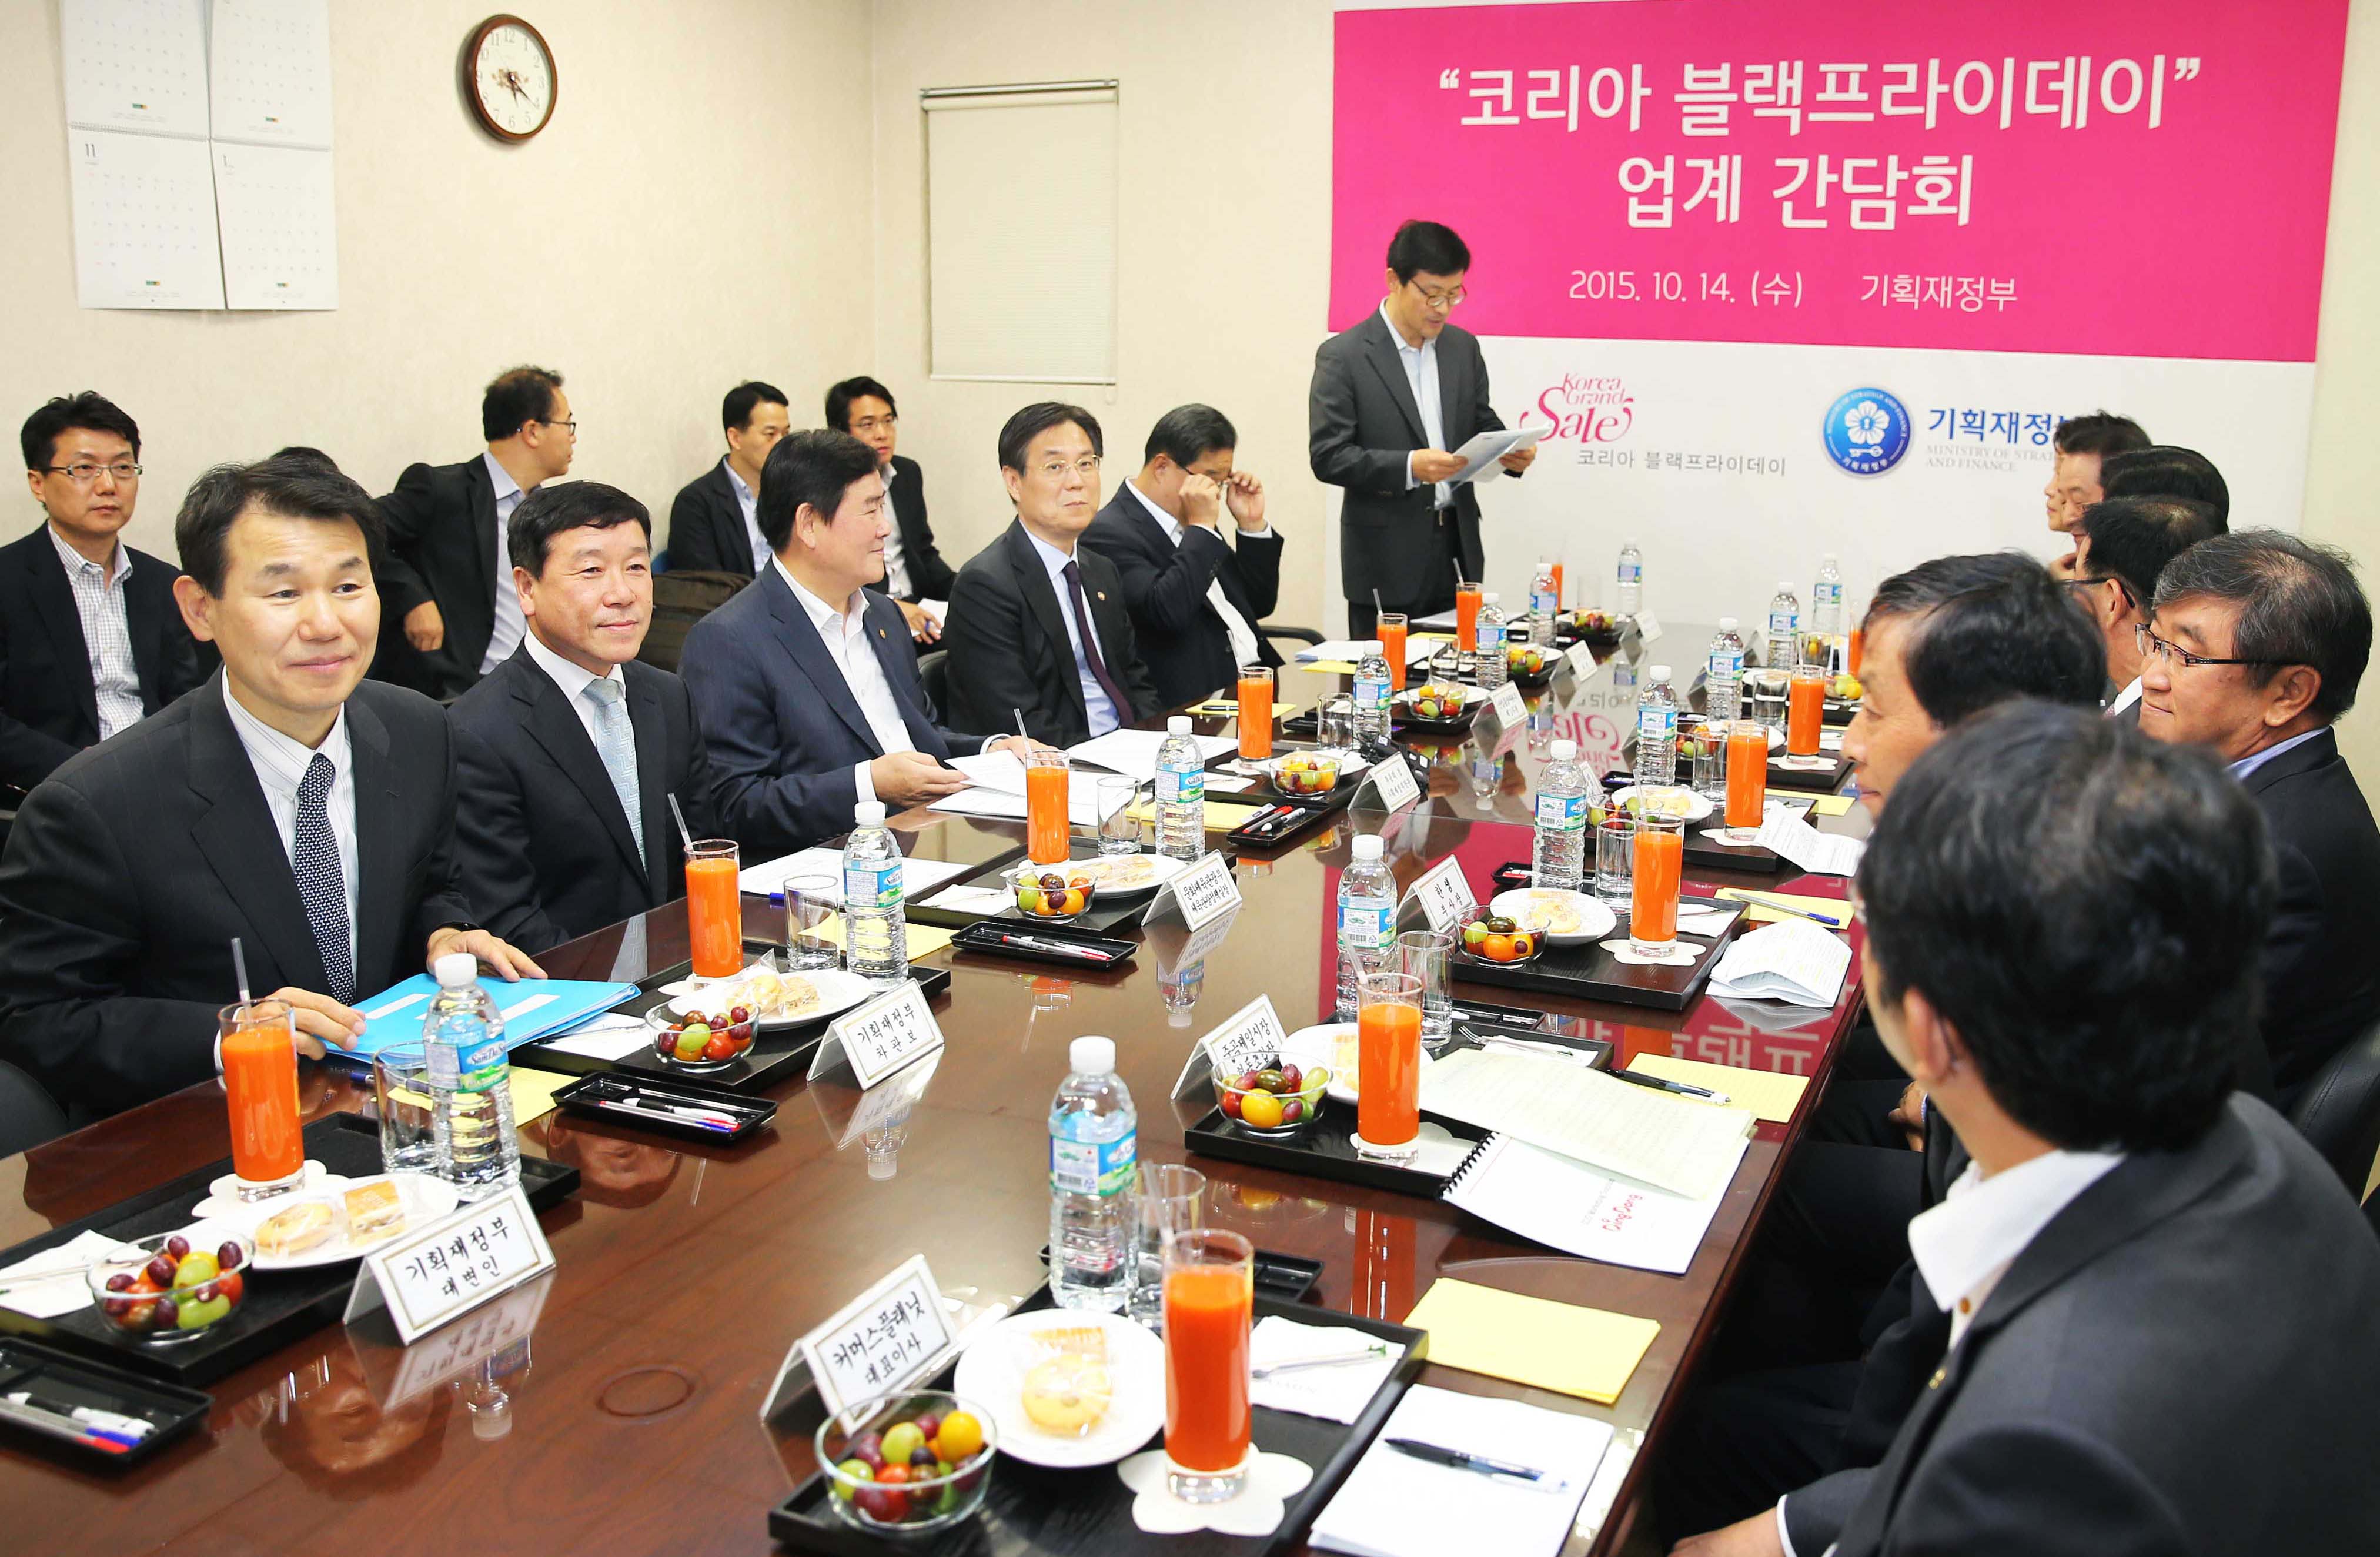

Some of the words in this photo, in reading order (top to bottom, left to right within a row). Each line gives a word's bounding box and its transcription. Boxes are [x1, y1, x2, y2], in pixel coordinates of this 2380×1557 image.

[1617, 154, 1743, 229] 업계
[1772, 154, 1974, 230] 간담회
[1569, 269, 1641, 302] 2015.
[1653, 270, 1687, 303] 10.
[1699, 272, 1736, 304] 14.
[1750, 269, 1804, 309] (수)
[1860, 273, 2019, 313] 기획재정부
[1562, 373, 1622, 392] Korea
[1565, 388, 1625, 405] Grand
[1519, 386, 1634, 443] Sale
[1929, 408, 2058, 446] 기획재정
[1577, 449, 1636, 469] 코리아
[1644, 451, 1786, 476] 블랙프라이데이
[1926, 444, 1992, 459] MINISTRY
[1993, 447, 2010, 459] OF
[2014, 450, 2053, 462] STRAT
[1927, 457, 1956, 468] AND
[1958, 459, 2015, 472] FINANCE
[857, 1003, 915, 1045] 기획재정부
[875, 1028, 918, 1060] 차관보
[405, 1215, 510, 1282] 기획재정부
[441, 1255, 501, 1297] 대변인
[833, 1290, 925, 1369] 커머스플래닛
[865, 1332, 923, 1385] 대표이사
